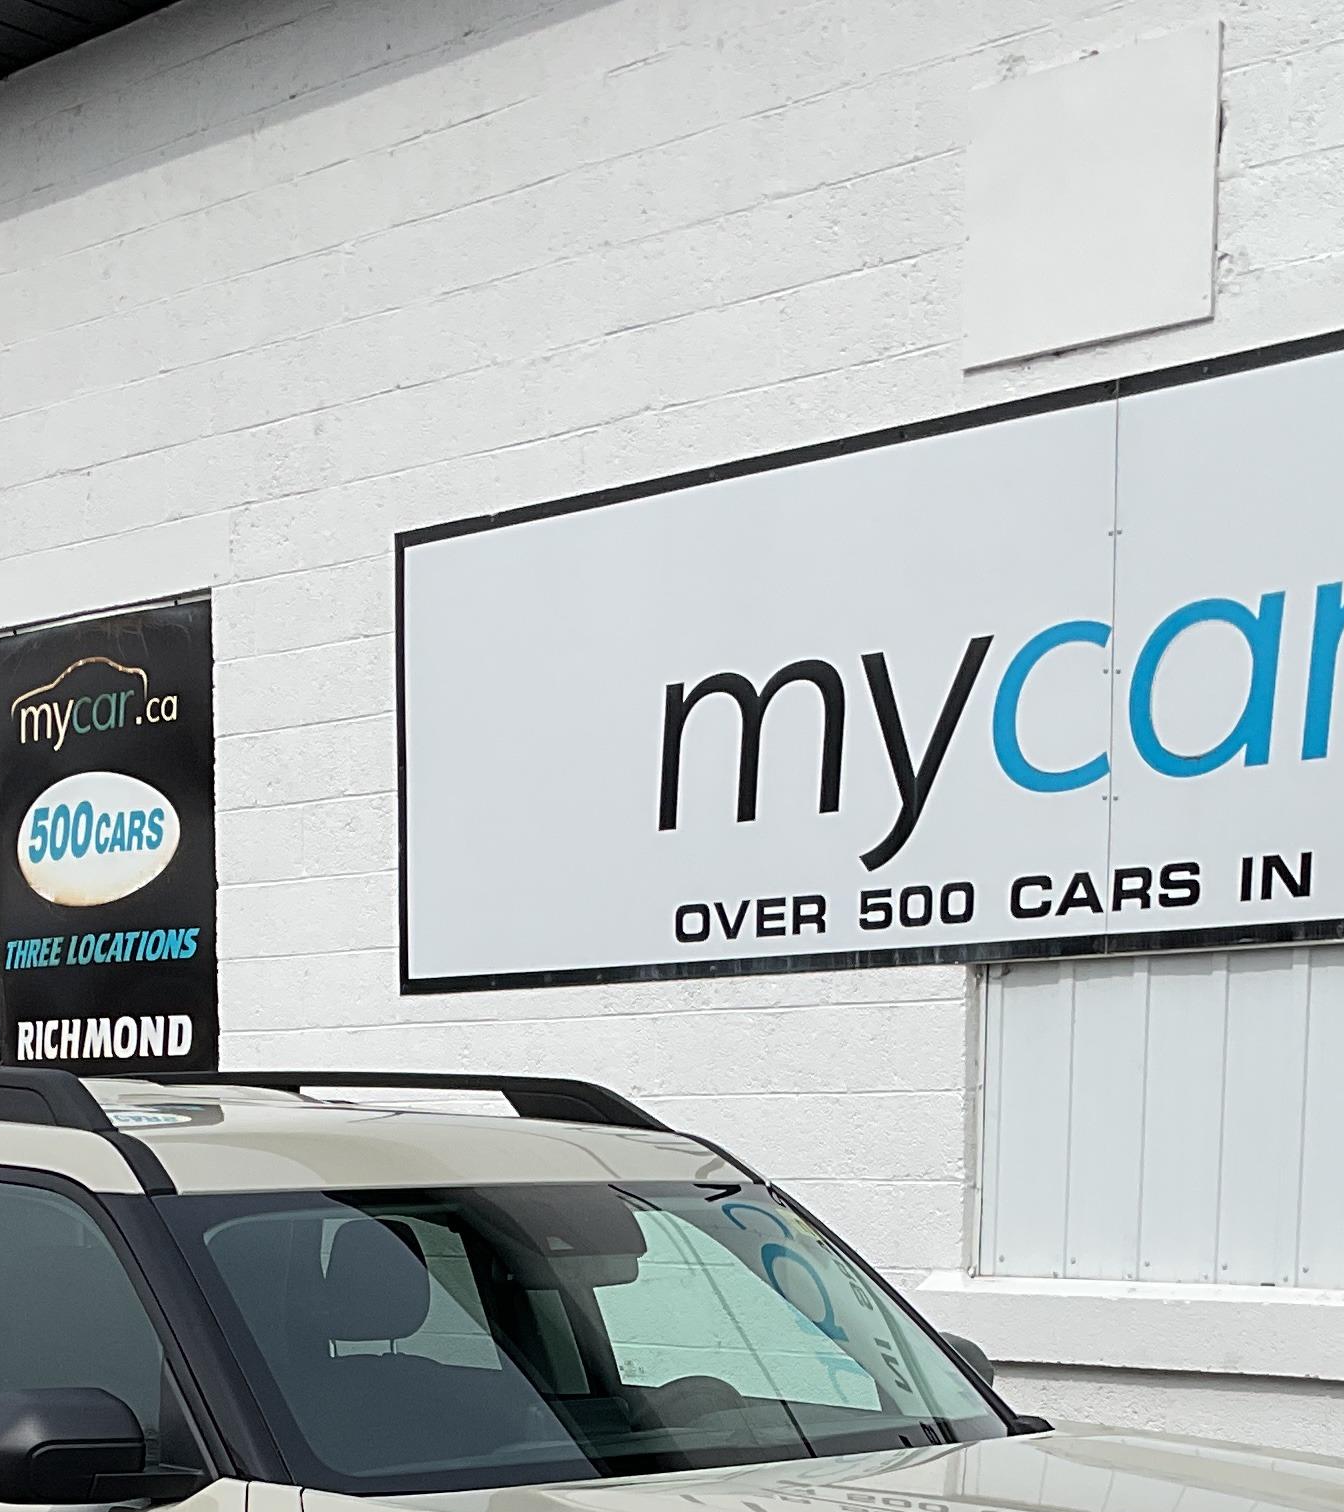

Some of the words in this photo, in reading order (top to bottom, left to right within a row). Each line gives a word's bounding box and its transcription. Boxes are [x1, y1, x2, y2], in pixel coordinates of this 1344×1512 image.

[19, 686, 179, 752] mycar.ca
[27, 799, 95, 865] 500
[94, 806, 166, 853] CARS
[674, 894, 827, 943] OVER
[858, 881, 975, 931] 500
[1009, 860, 1202, 920] CARS
[1239, 851, 1313, 902] IN
[4, 936, 62, 971] THREE
[66, 926, 201, 967] LOCATIONS
[16, 1014, 193, 1061] RICHMOND
